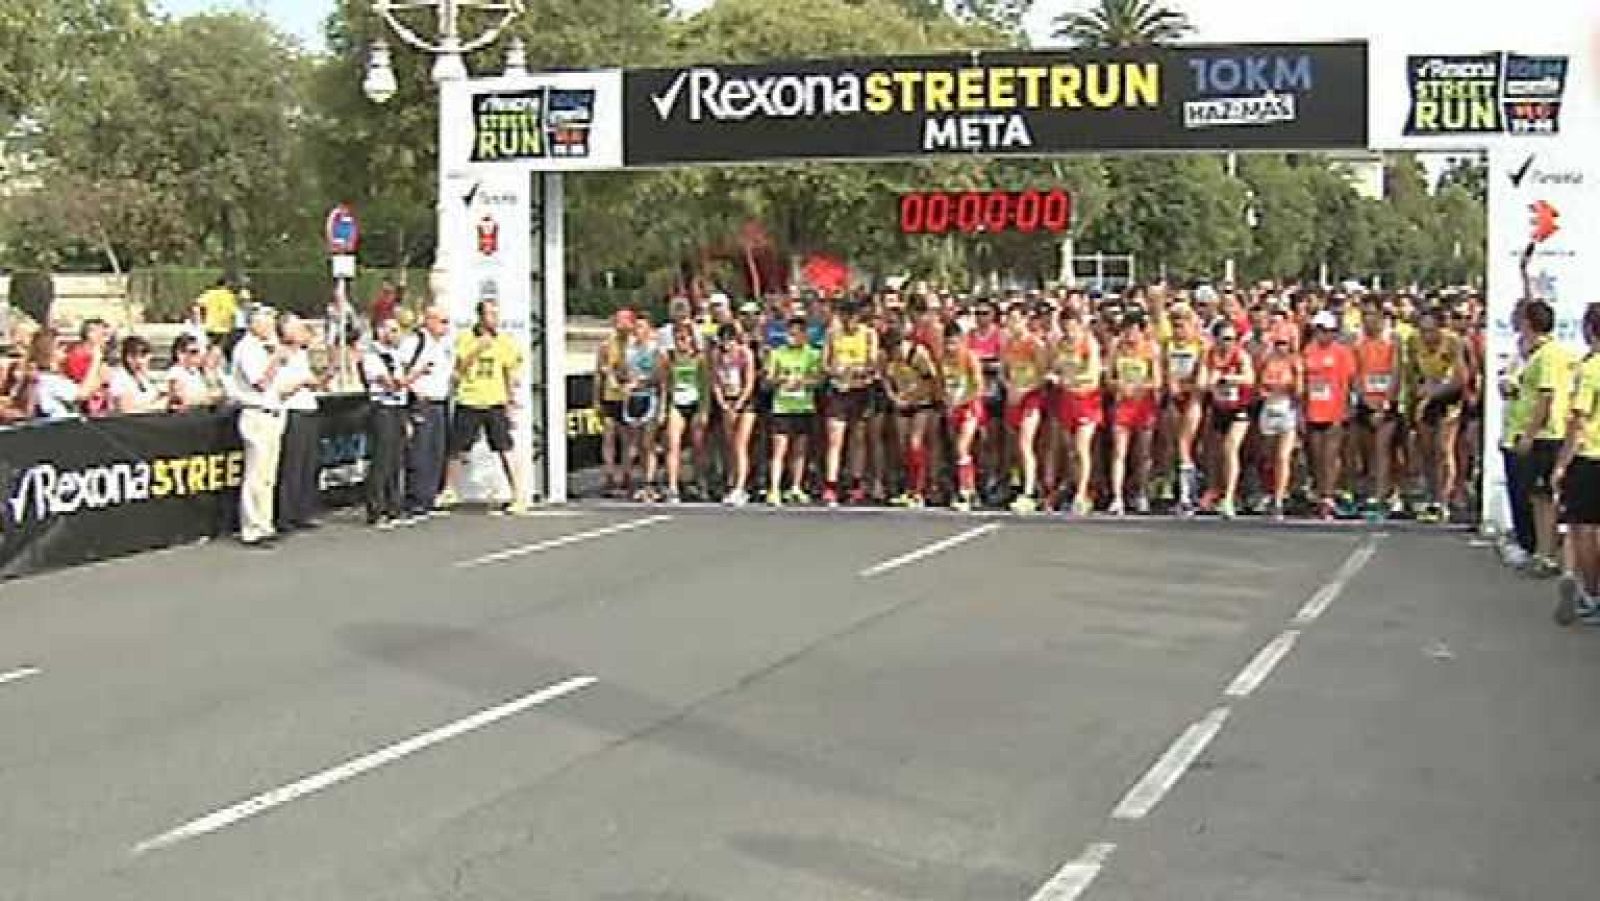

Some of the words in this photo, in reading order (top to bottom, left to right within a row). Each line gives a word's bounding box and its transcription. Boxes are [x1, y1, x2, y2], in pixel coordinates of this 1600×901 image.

[1189, 56, 1312, 91] 10KM
[689, 68, 861, 121] Rexona
[864, 62, 1160, 113] STREETRUN
[923, 114, 1033, 150] META
[1415, 101, 1497, 129] RUN
[480, 128, 541, 159] RUN
[151, 452, 243, 496] STREE
